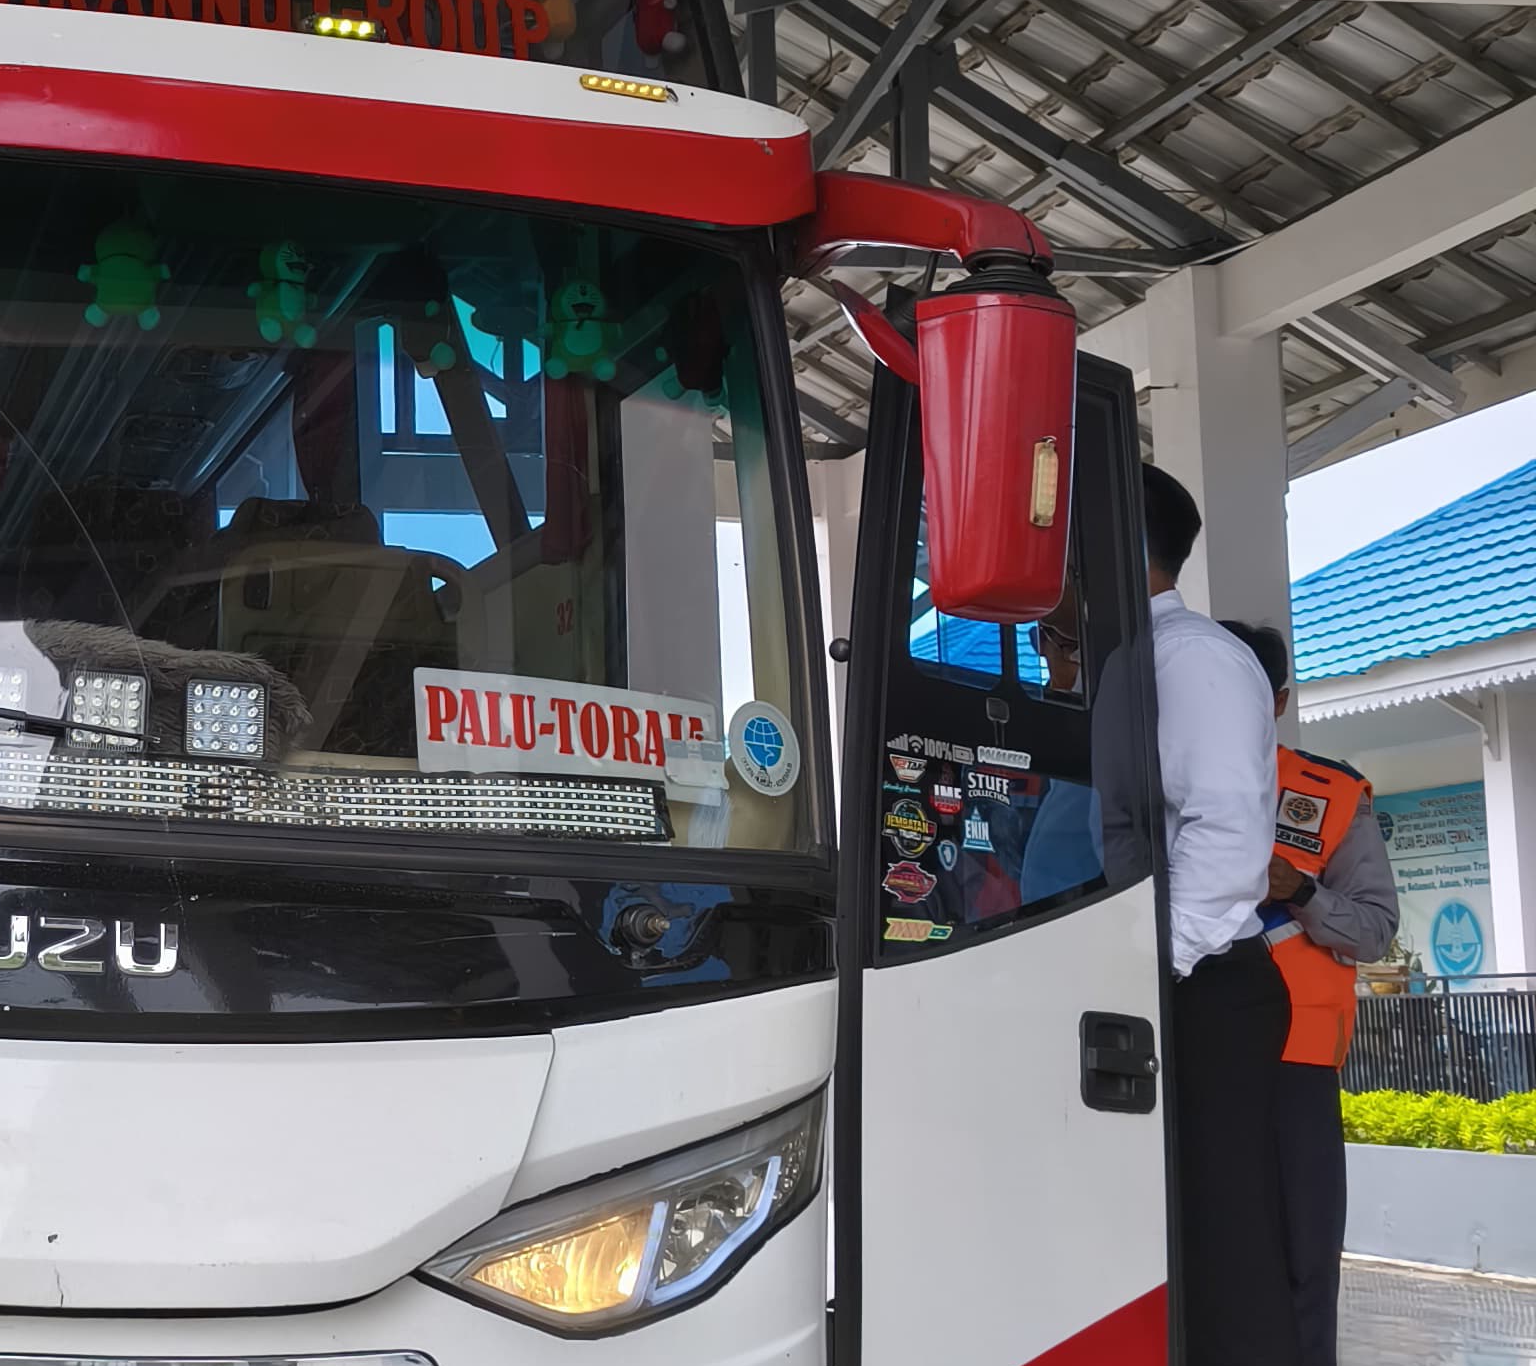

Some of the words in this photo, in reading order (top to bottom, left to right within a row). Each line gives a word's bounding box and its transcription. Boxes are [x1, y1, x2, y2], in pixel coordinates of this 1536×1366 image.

[924, 737, 952, 762] 100%
[968, 772, 1009, 795] STUFF
[968, 789, 1010, 805] COLLECTION
